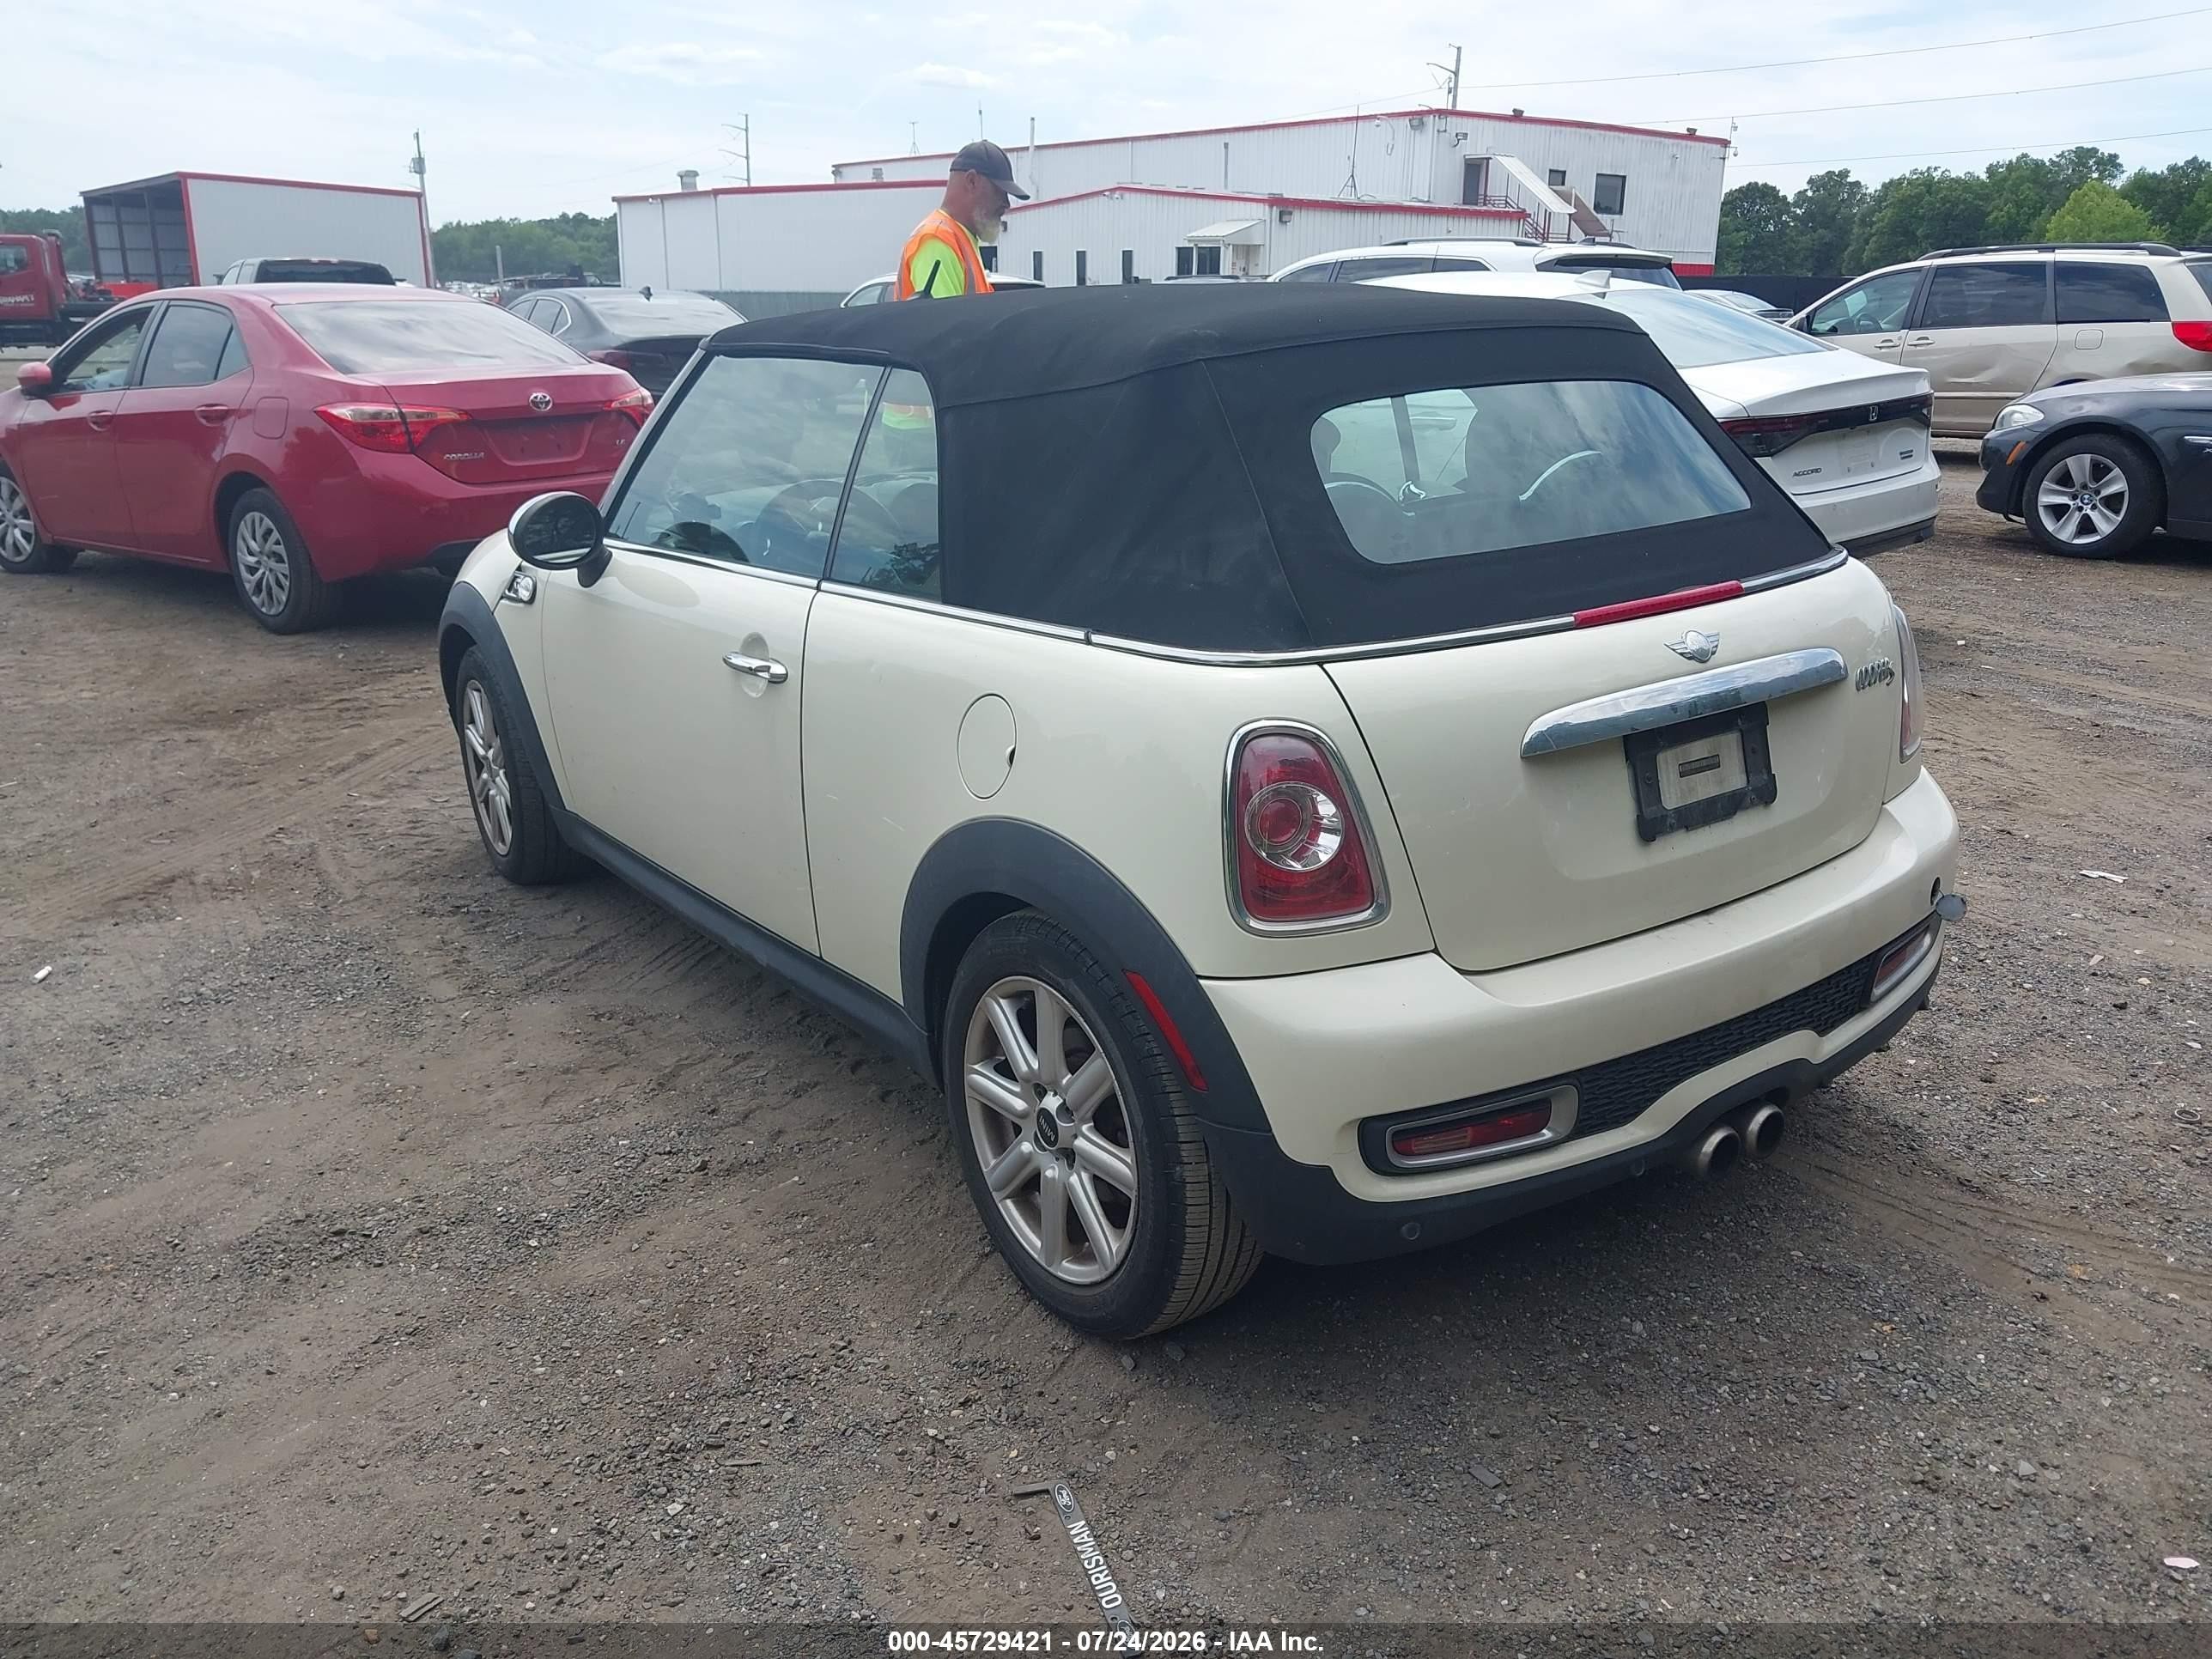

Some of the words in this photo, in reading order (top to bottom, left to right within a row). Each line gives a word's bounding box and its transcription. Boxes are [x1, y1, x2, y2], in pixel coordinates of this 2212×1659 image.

[1792, 467, 1822, 477] ACCORD
[1039, 1115, 1056, 1142] MINI
[1066, 1519, 1122, 1610] OURISMAN
